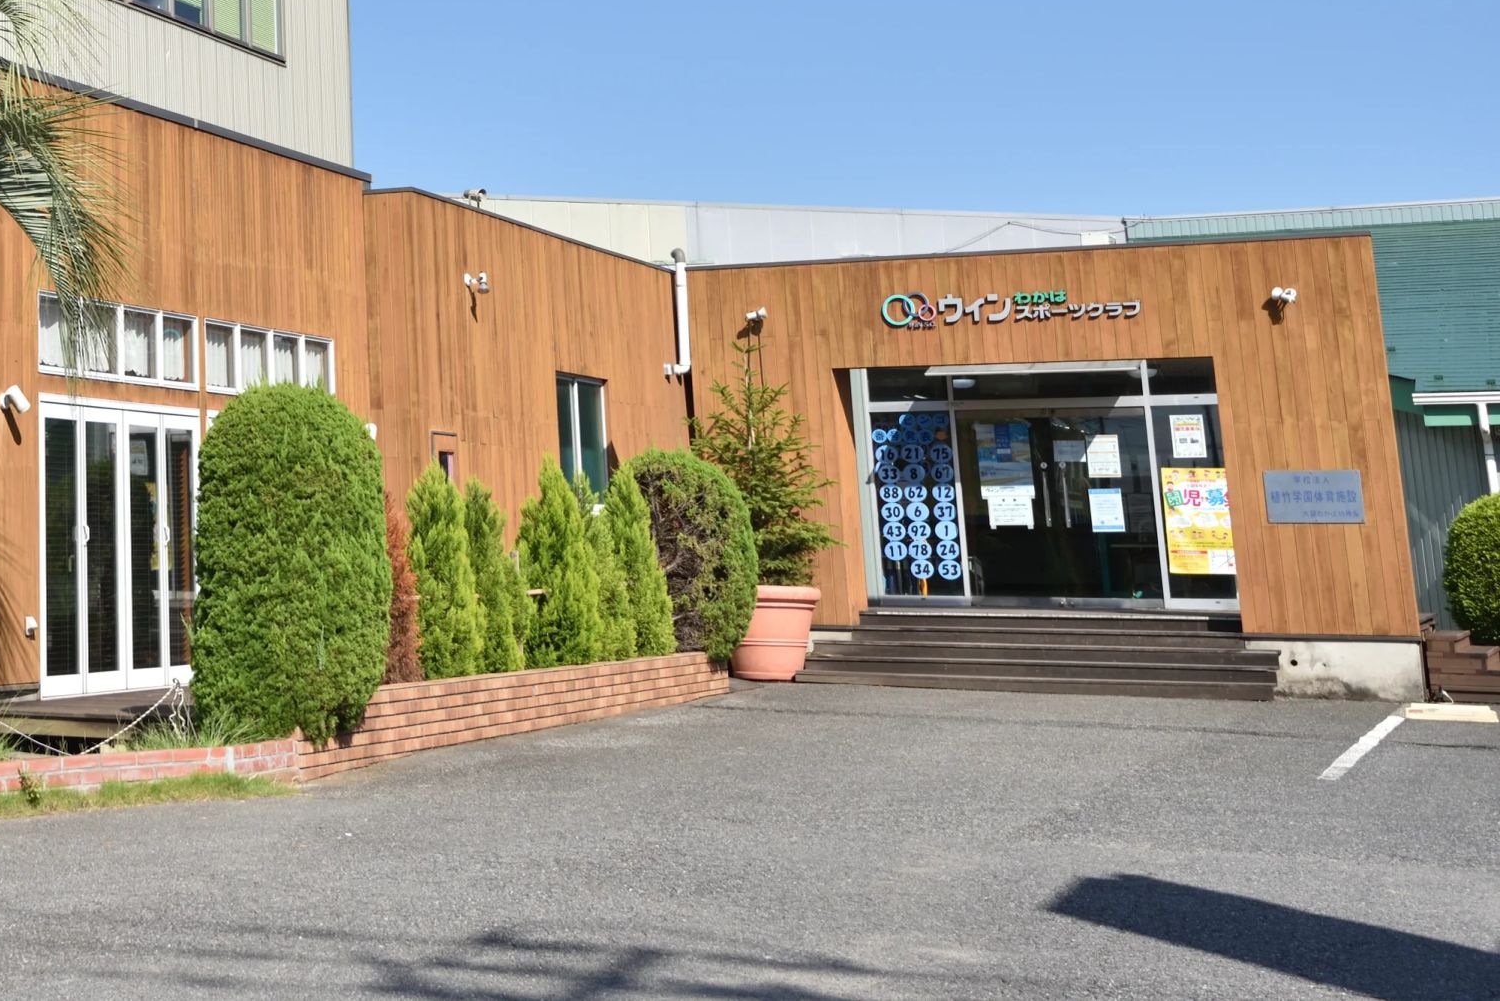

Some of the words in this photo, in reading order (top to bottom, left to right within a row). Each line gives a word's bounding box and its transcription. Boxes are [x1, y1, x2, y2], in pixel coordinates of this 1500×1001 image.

[1015, 300, 1141, 320] スポーツクラブ
[881, 449, 894, 460] 16
[904, 448, 919, 459] 21
[933, 448, 949, 459] 75
[882, 468, 897, 480] 33
[935, 467, 950, 479] 67
[883, 487, 899, 499] 88
[908, 486, 923, 498] 62
[937, 486, 952, 498] 12
[885, 506, 900, 518] 30
[937, 506, 952, 518] 37
[886, 525, 902, 537] 43
[911, 525, 927, 536] 92
[889, 545, 902, 557] 11
[912, 544, 928, 556] 78
[940, 544, 956, 556] 24
[914, 563, 930, 575] 34
[942, 564, 958, 575] 53
